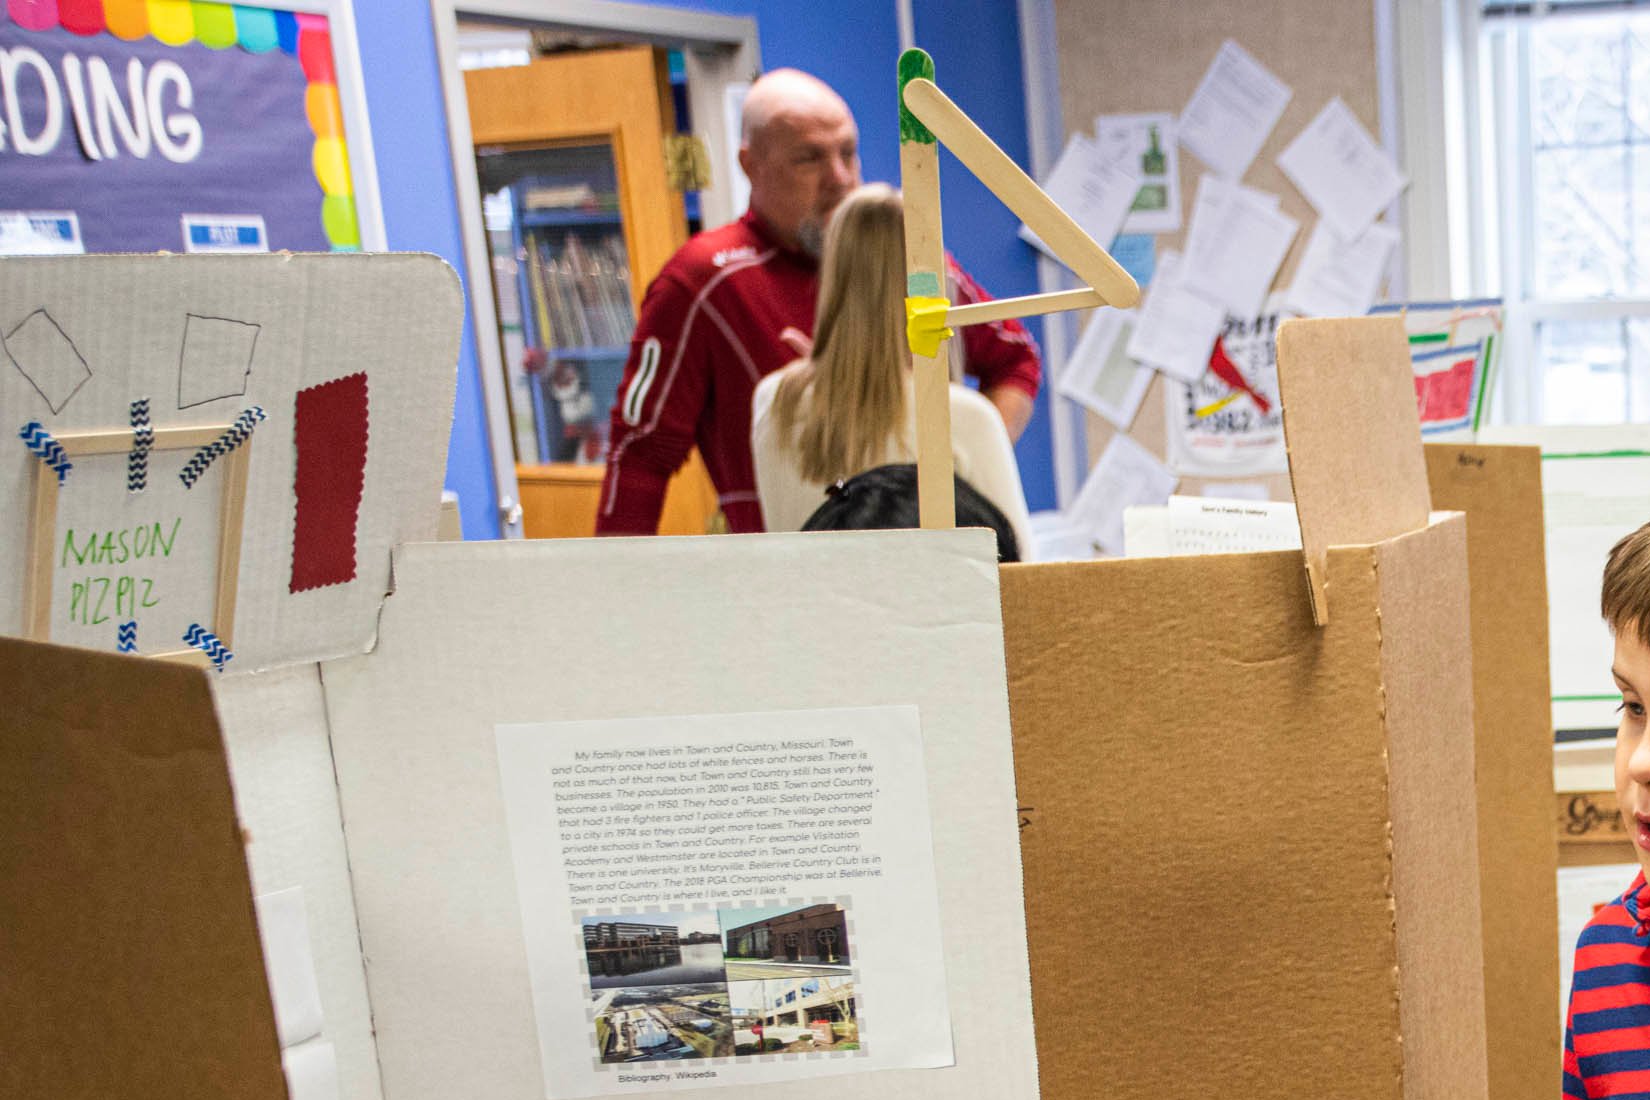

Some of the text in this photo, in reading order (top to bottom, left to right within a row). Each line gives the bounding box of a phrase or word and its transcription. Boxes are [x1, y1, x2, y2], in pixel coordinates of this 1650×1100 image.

[0, 46, 203, 163] DING
[62, 517, 181, 568] MASON
[575, 751, 590, 761] My
[592, 750, 622, 760] family
[625, 750, 646, 758] now
[648, 748, 671, 756] lives
[685, 745, 710, 754] Town
[713, 744, 734, 754] and
[828, 738, 854, 747] Town
[551, 766, 572, 775] and
[574, 764, 616, 774] Country
[617, 763, 644, 771] once
[646, 761, 666, 770] had
[668, 761, 687, 769] lots
[689, 759, 700, 768] of
[702, 758, 730, 767] white
[731, 757, 765, 765] fences
[767, 755, 787, 764] and
[828, 751, 857, 760] There
[553, 779, 571, 788] not
[588, 777, 617, 786] much
[619, 775, 630, 785] of
[632, 775, 653, 784] that
[679, 773, 697, 782] but
[700, 771, 725, 781] Town
[727, 770, 748, 779] and
[750, 768, 791, 778] Country
[793, 767, 810, 776] still
[813, 767, 832, 775] has
[834, 766, 855, 774] very
[857, 764, 873, 773] few
[616, 788, 636, 798] The
[637, 787, 694, 797] population
[707, 784, 729, 794] 2010
[730, 784, 750, 792] was
[783, 780, 808, 790] Town
[810, 779, 831, 788] and
[832, 777, 872, 787] Country
[610, 803, 642, 812] village
[683, 798, 706, 808] They
[708, 798, 730, 807] had
[731, 798, 738, 806] a
[779, 793, 810, 803] Safety
[813, 791, 873, 801] Department
[559, 819, 580, 827] that
[582, 817, 603, 826] had
[614, 815, 630, 824] fire
[632, 815, 671, 825] fighters
[673, 813, 694, 822] and
[702, 812, 734, 821] police
[772, 807, 791, 816] The
[793, 806, 826, 816] village
[827, 804, 873, 814] changed
[561, 833, 571, 841] to
[583, 831, 601, 839] city
[639, 829, 651, 837] so
[678, 825, 706, 835] could
[708, 825, 725, 835] get
[728, 824, 754, 832] more
[787, 819, 816, 828] There
[837, 818, 871, 826] several
[562, 845, 599, 854] private
[601, 843, 640, 851] schools
[655, 839, 679, 848] Town
[681, 839, 702, 847] and
[749, 834, 766, 844] For
[768, 833, 810, 843] example
[812, 831, 860, 840] Visitation
[564, 858, 610, 866] Academy
[613, 855, 634, 864] and
[699, 852, 716, 860] are
[718, 849, 757, 858] located
[759, 848, 768, 856] in
[771, 846, 795, 855] Town
[797, 845, 818, 854] and
[567, 870, 595, 879] There
[748, 861, 791, 870] Bellerive
[793, 858, 834, 868] Country
[835, 856, 859, 865] Club
[861, 856, 870, 864] is
[568, 883, 593, 892] Town
[595, 882, 616, 891] and
[663, 878, 683, 887] The
[707, 875, 728, 885] PGA
[729, 873, 803, 883] Championship
[804, 872, 824, 880] was
[826, 870, 837, 879] at
[570, 896, 594, 905] Town
[597, 895, 618, 904] and
[620, 893, 660, 903] Country
[663, 892, 671, 900] is
[673, 891, 703, 899] where
[732, 888, 753, 897] and
[760, 886, 777, 895] like
[676, 1071, 717, 1079] Wikipedia
